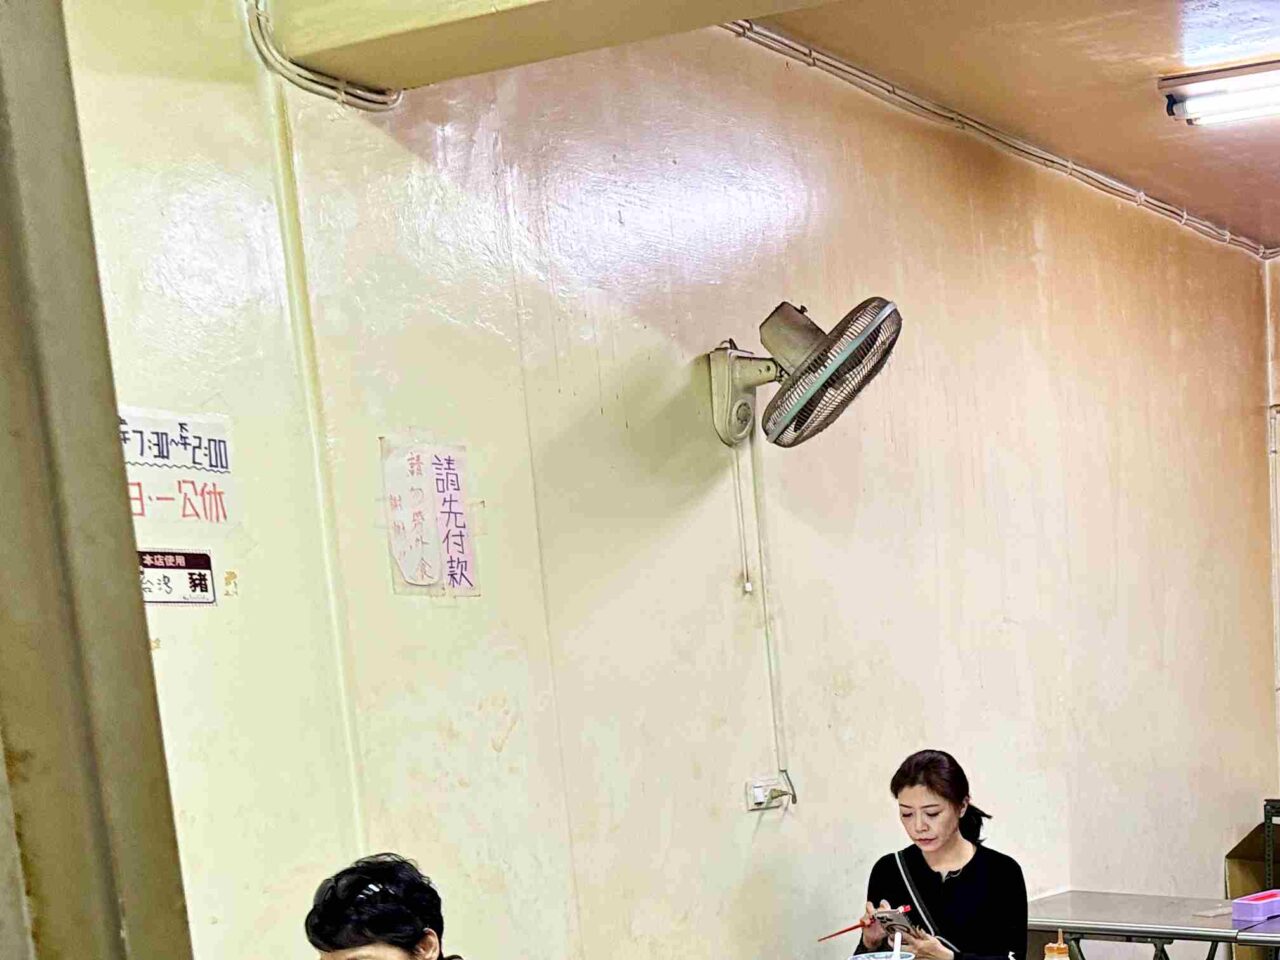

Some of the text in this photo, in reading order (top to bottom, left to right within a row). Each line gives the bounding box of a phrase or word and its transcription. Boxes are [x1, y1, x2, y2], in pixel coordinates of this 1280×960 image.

[431, 454, 474, 588] 請先付款
[187, 571, 209, 593] 豬
